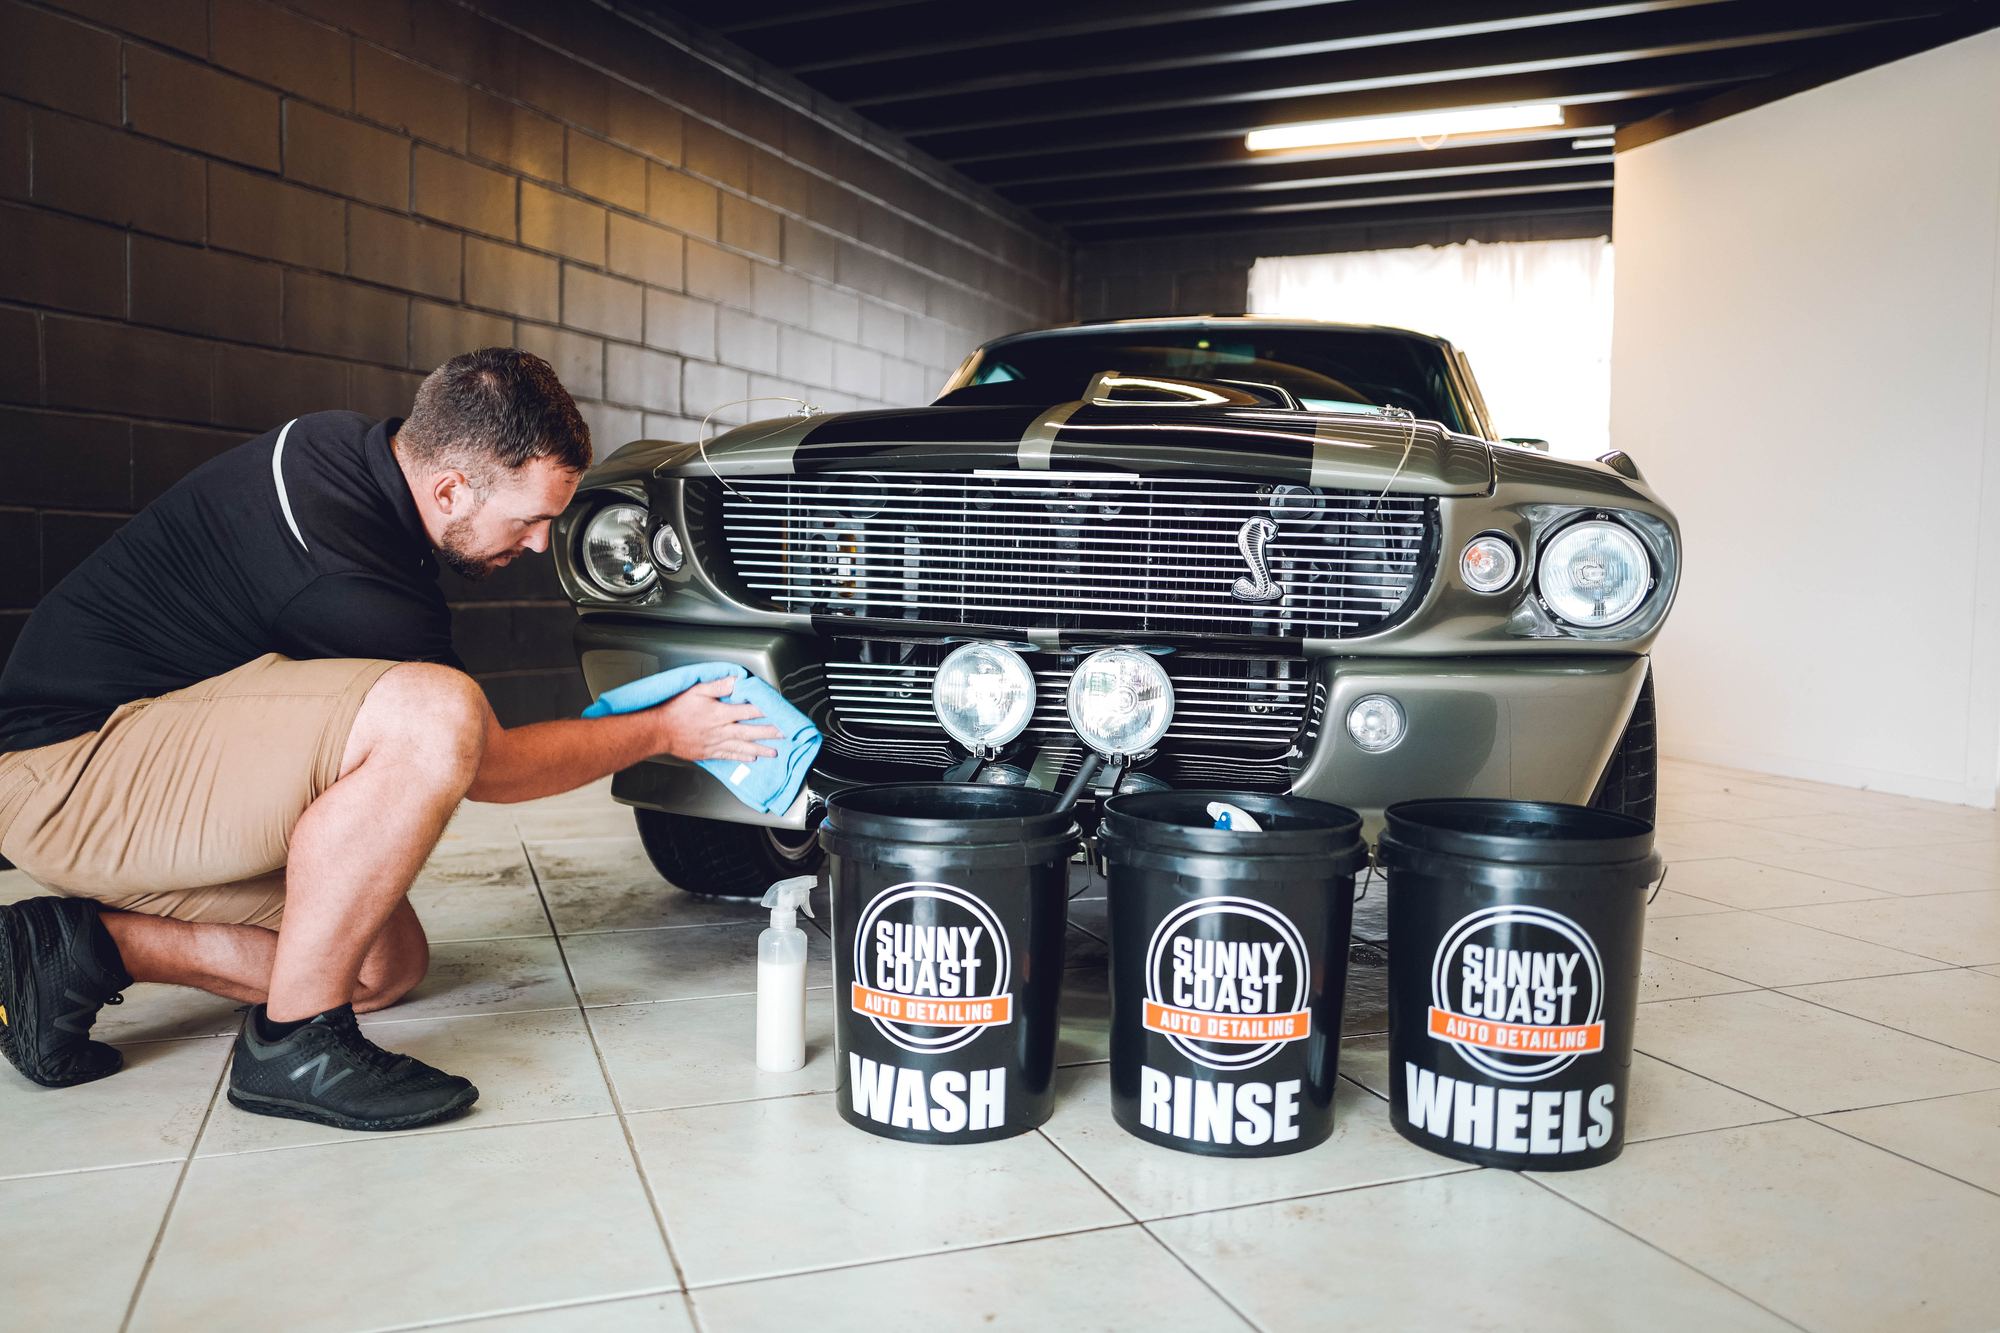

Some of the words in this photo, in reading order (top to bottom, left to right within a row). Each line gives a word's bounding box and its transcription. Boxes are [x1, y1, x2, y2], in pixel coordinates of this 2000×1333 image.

[876, 920, 982, 964] SUNNY
[1172, 935, 1285, 980] SUNNY
[876, 952, 981, 997] COAST
[1461, 943, 1580, 990] SUNNY
[864, 994, 900, 1018] AUTO
[906, 1001, 993, 1021] DETAILING
[1172, 967, 1283, 1014] COAST
[1461, 975, 1577, 1025] COAST
[1159, 1010, 1201, 1034] AUTO
[1207, 1016, 1295, 1038] DETAILING
[1445, 1016, 1490, 1043] AUTO
[1495, 1029, 1588, 1050] DETAILING
[849, 1051, 1007, 1133] WASH
[1139, 1064, 1301, 1146] RINSE
[1405, 1061, 1615, 1155] WHEELS
